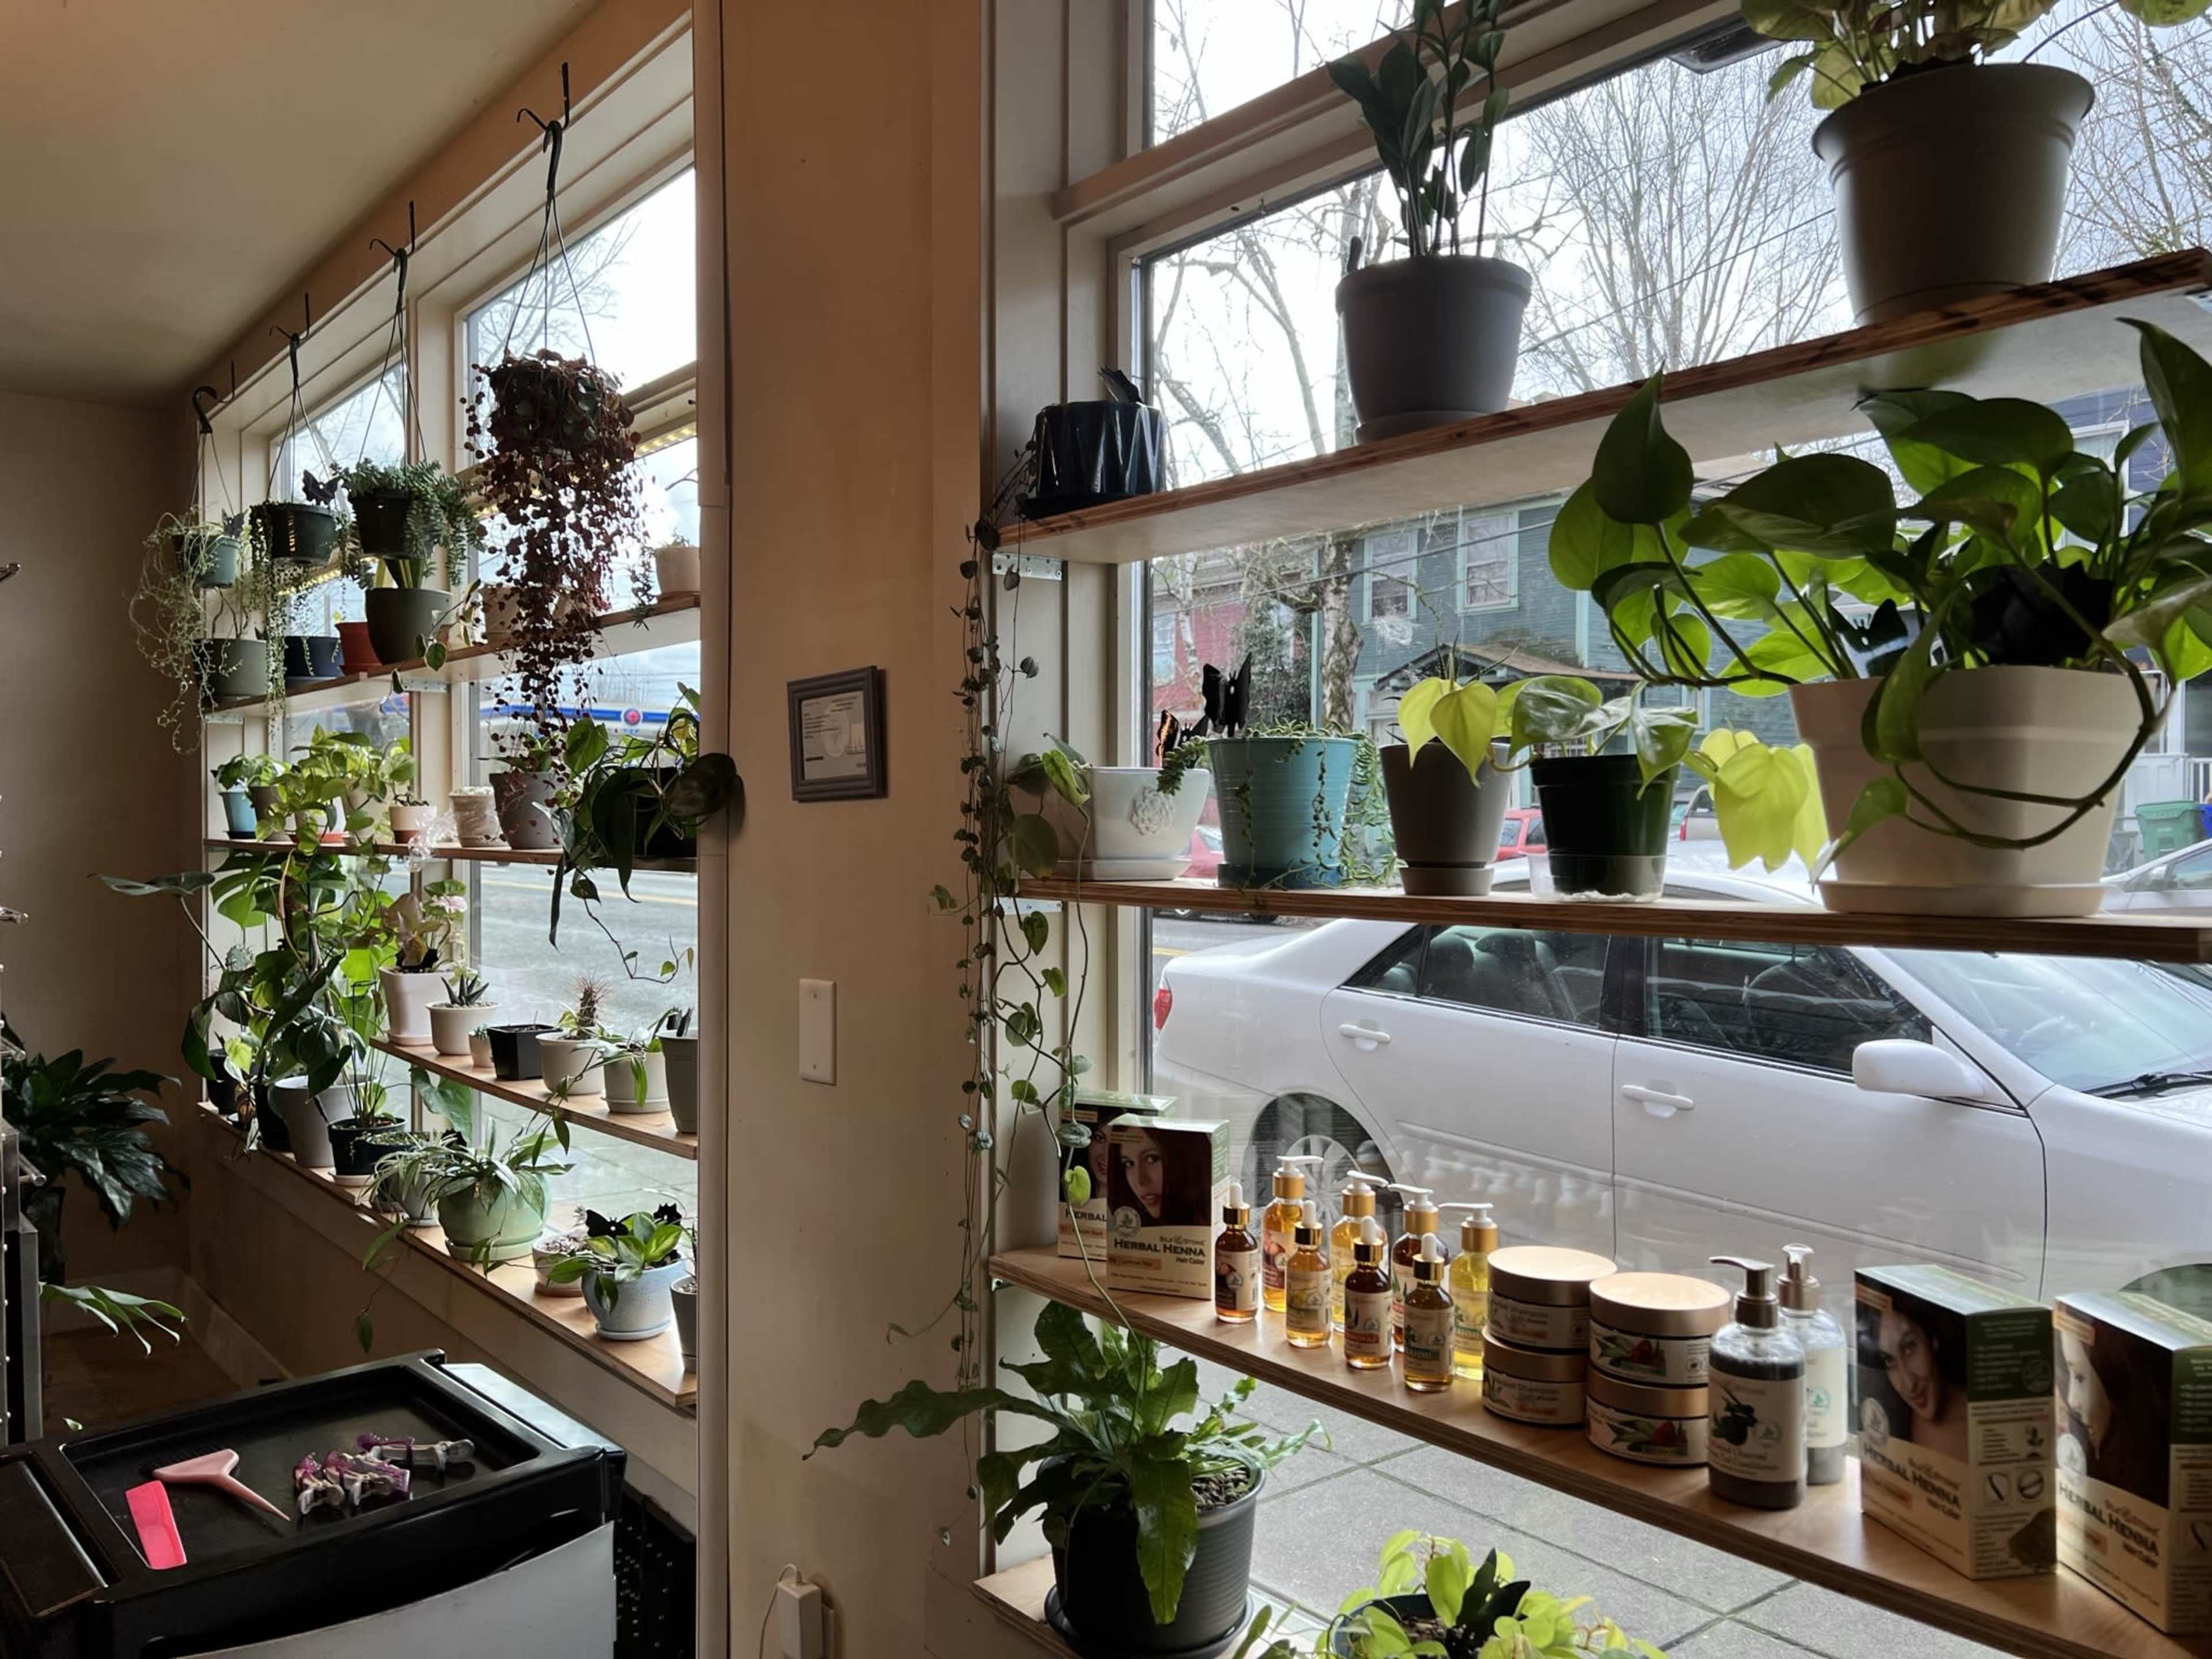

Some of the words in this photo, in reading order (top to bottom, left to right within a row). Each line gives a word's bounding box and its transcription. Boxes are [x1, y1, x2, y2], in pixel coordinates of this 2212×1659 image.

[1114, 1238, 1161, 1253] HERBAL
[1163, 1244, 1206, 1257] HENNA
[1864, 1441, 1910, 1482] HERBAL
[1912, 1470, 1961, 1509] HENNA
[2059, 1481, 2107, 1525] HERBAL
[2108, 1512, 2158, 1556] HENNA
